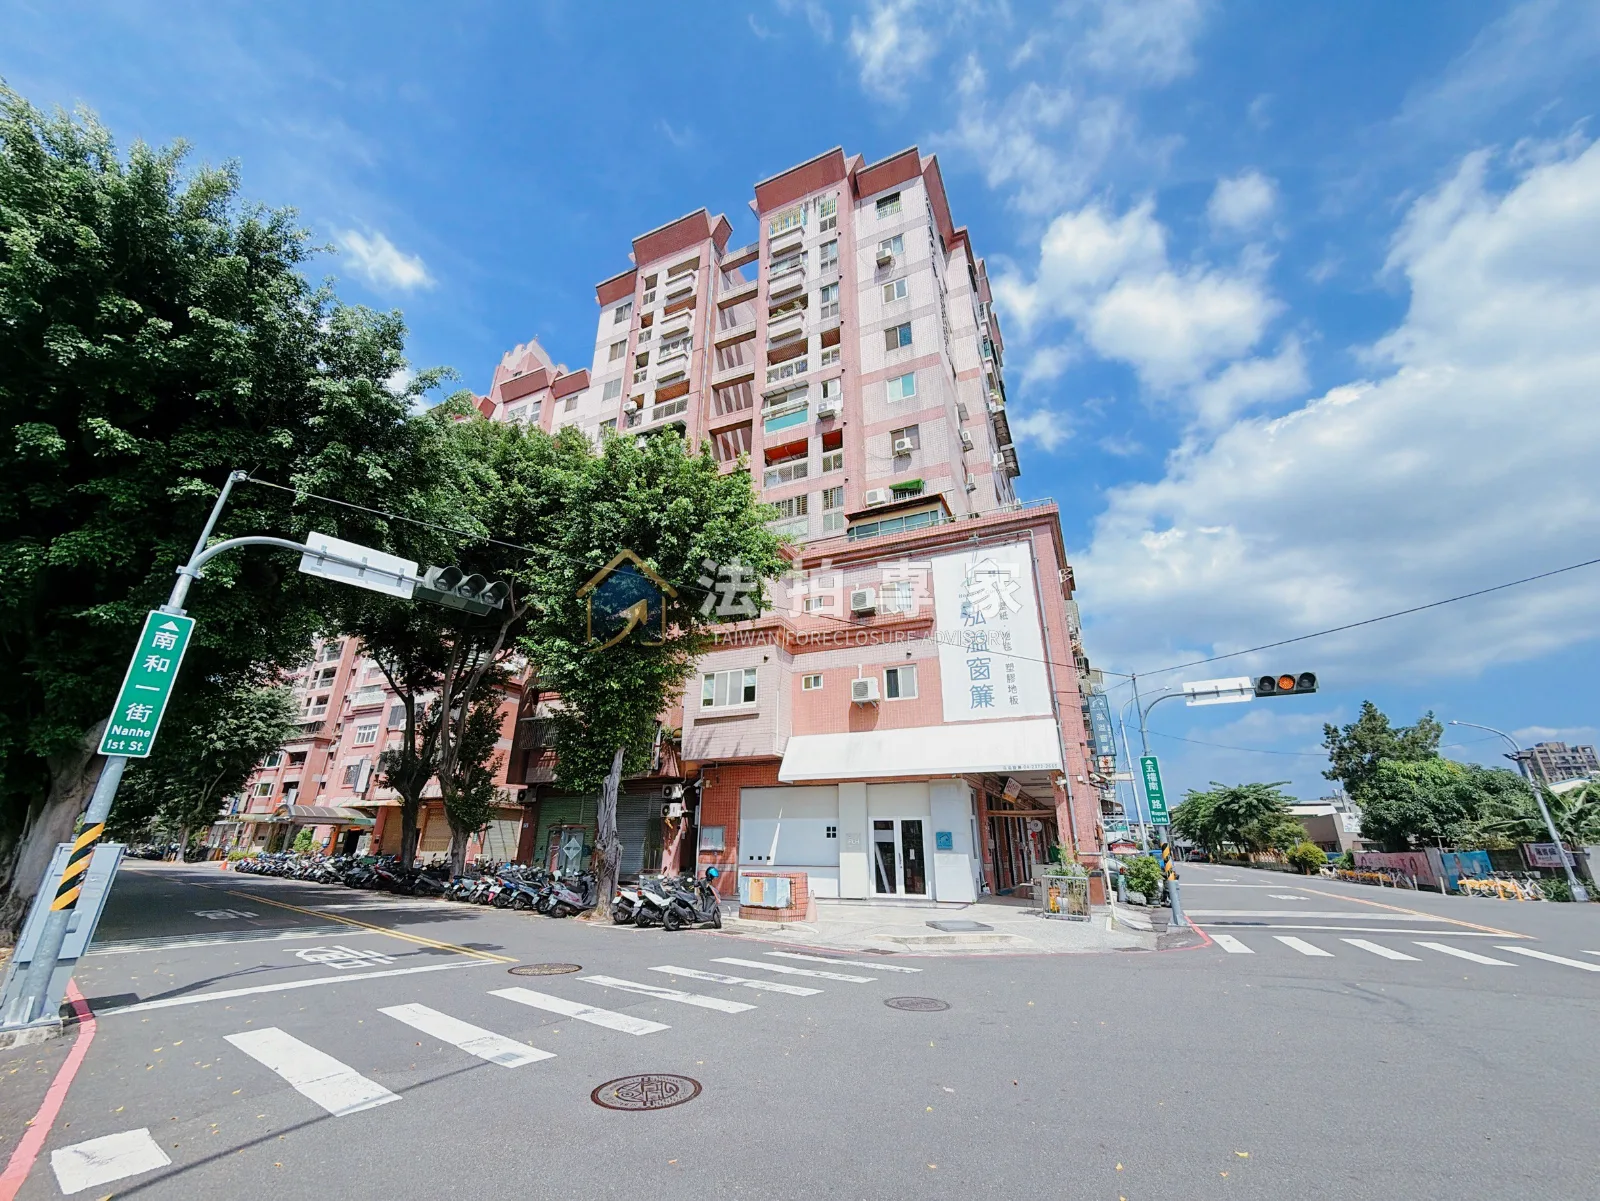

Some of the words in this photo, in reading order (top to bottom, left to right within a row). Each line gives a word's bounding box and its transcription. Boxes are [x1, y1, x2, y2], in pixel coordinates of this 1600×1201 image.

[126, 631, 178, 723] 南和一街
[106, 739, 125, 750] 1st
[128, 740, 145, 751] St.
[111, 725, 151, 738] Nanhe
[1145, 764, 1162, 809] 五權南一路
